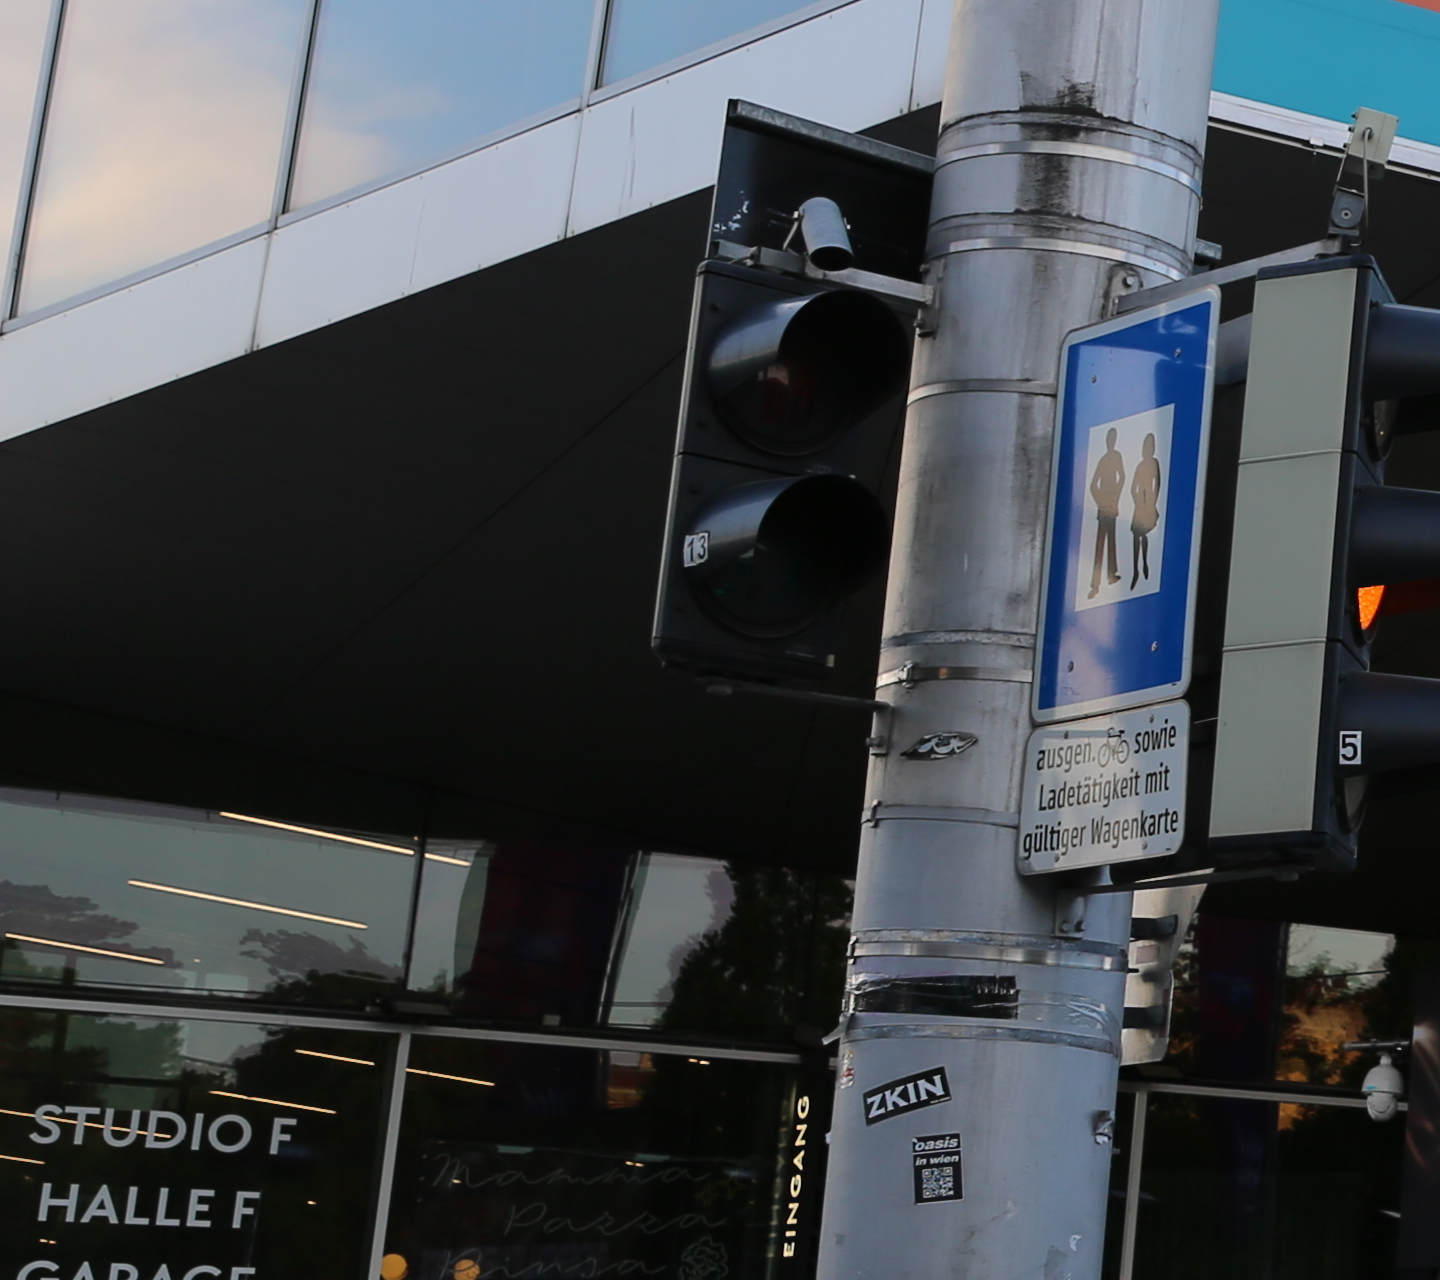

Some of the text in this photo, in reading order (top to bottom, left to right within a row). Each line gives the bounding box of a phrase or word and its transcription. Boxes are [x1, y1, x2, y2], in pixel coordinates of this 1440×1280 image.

[687, 534, 708, 564] 13
[1036, 718, 1177, 773] ausgen. sowie
[1340, 733, 1359, 762] 5
[1038, 761, 1171, 812] Ladetätigkeit mit
[1022, 807, 1179, 861] gültiger Wagenkarte
[866, 1074, 945, 1119] ZKIN
[28, 1103, 299, 1156] STUDIO F
[914, 1136, 959, 1151] oasis
[782, 1094, 811, 1258] EINGANG
[914, 1154, 960, 1167] in wien
[36, 1181, 262, 1230] HALLE F
